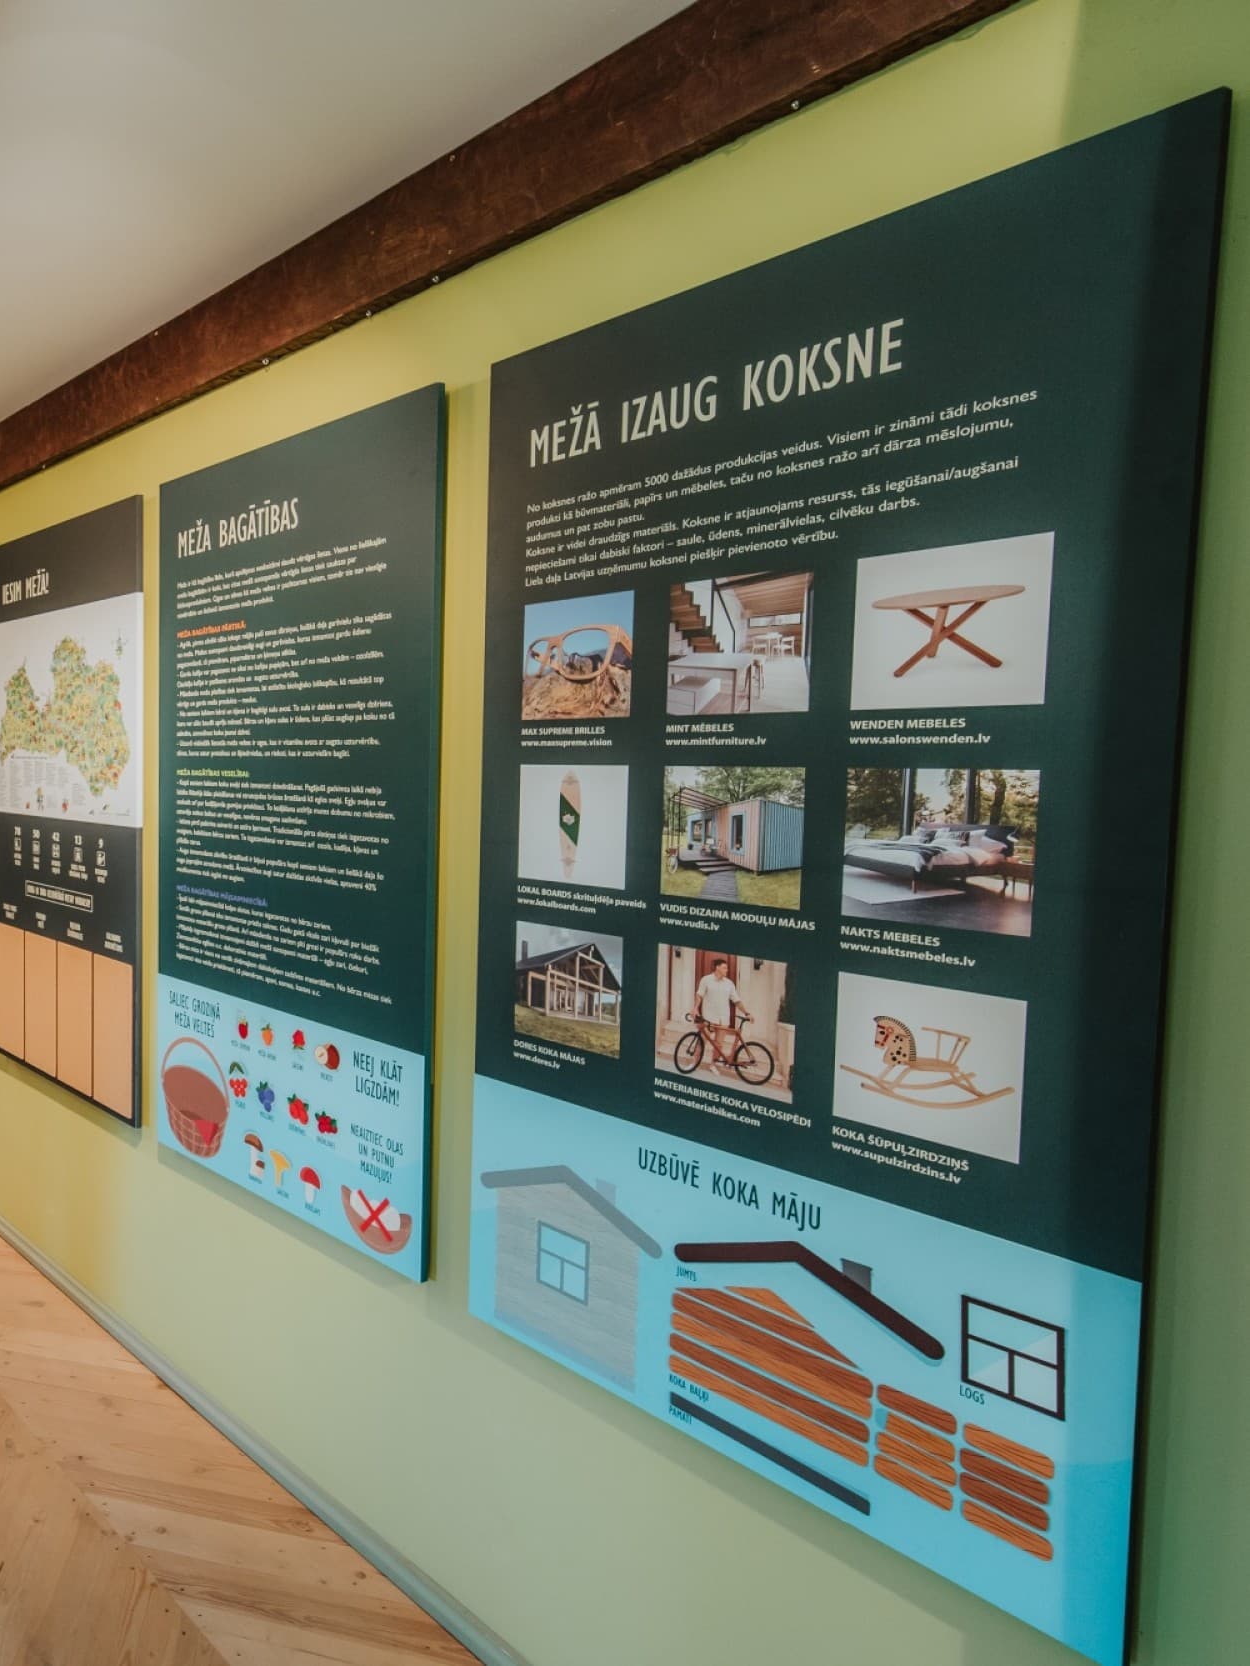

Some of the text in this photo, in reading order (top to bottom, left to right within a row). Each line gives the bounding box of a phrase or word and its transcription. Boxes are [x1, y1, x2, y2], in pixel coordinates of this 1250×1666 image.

[529, 317, 904, 468] MEŽĀ IZAUG KOKSNE
[598, 481, 642, 499] apmēram
[643, 471, 669, 487] 5000
[670, 464, 712, 481] dažādus
[713, 449, 778, 474] produkcijas
[780, 440, 822, 456] veidus.
[826, 428, 870, 445] Visiem
[873, 423, 885, 435] ir
[888, 410, 934, 432] zināmi
[939, 402, 967, 421] tādi
[972, 389, 1037, 413] koksnes
[633, 492, 662, 508] papīrs
[664, 489, 678, 499] un
[680, 478, 727, 496] mēbeles,
[729, 471, 753, 485] taču
[756, 469, 772, 480] no
[775, 457, 824, 476] koksnes
[828, 449, 857, 464] ražo
[860, 442, 880, 457] arī
[882, 436, 921, 452] dārza
[925, 417, 1013, 444] mēslojumu,
[587, 531, 630, 546] draudzīgs
[632, 520, 679, 538] materiāls.
[681, 514, 721, 529] Koksne
[723, 510, 733, 521] ir
[735, 498, 804, 520] atjaunojams
[807, 489, 857, 506] resurss,
[860, 482, 881, 496] tās
[885, 455, 1019, 492] iegūšanai/augšanai
[178, 497, 299, 559] MEŽA BAGĀTĪBAS
[592, 517, 615, 530] zobu
[616, 513, 645, 527] pastu.
[598, 545, 630, 559] dabiski
[632, 539, 664, 554] faktori
[675, 533, 705, 547] saule,
[707, 528, 743, 541] ūdens,
[745, 512, 825, 535] minerālvielas,
[828, 503, 874, 521] cilvēku
[877, 495, 920, 512] darbs.
[596, 560, 647, 576] uzņēmumu
[648, 551, 687, 568] koksnei
[689, 546, 725, 564] piešķir
[727, 538, 788, 558] pievienoto
[790, 529, 838, 545] vērtību.
[2, 568, 50, 605] IESIM MEŽĀ!
[537, 726, 574, 735] SUPREME
[573, 725, 605, 735] BRILLES
[665, 722, 734, 733] MINT MĒBELES
[849, 717, 966, 730] WENDEN MEBELES
[664, 735, 766, 746] www.mintfurniture.lv
[848, 732, 991, 744] www.salonswenden.lv
[540, 887, 572, 899] BOARDS
[658, 916, 720, 931] www.vudis.lv
[659, 902, 815, 930] VUDIS DIZAINA MODUĻU MĀJAS
[840, 925, 940, 947] NAKTS MEBELES
[839, 941, 976, 967] www.naktsmebeles.lv
[174, 1010, 191, 1030] MEŽA
[353, 1050, 403, 1083] NEEJ KLĀT
[537, 1045, 559, 1058] KOKA
[558, 1051, 585, 1065] MĀJAS
[355, 1075, 400, 1107] LIGZDĀM!
[653, 1076, 811, 1128] MATERIABIKES KOKA VELOSIPĒDI
[653, 1090, 760, 1127] www.materiabikes.com
[350, 1122, 383, 1147] NEAIZTIEC
[831, 1125, 865, 1143] KOKA
[358, 1143, 395, 1168] UN PUTNU
[831, 1141, 961, 1184] www.supulzirdzins.lv
[637, 1146, 821, 1232] UZBŪVĒ KOKA MĀJU
[958, 1384, 986, 1405] LOGS
